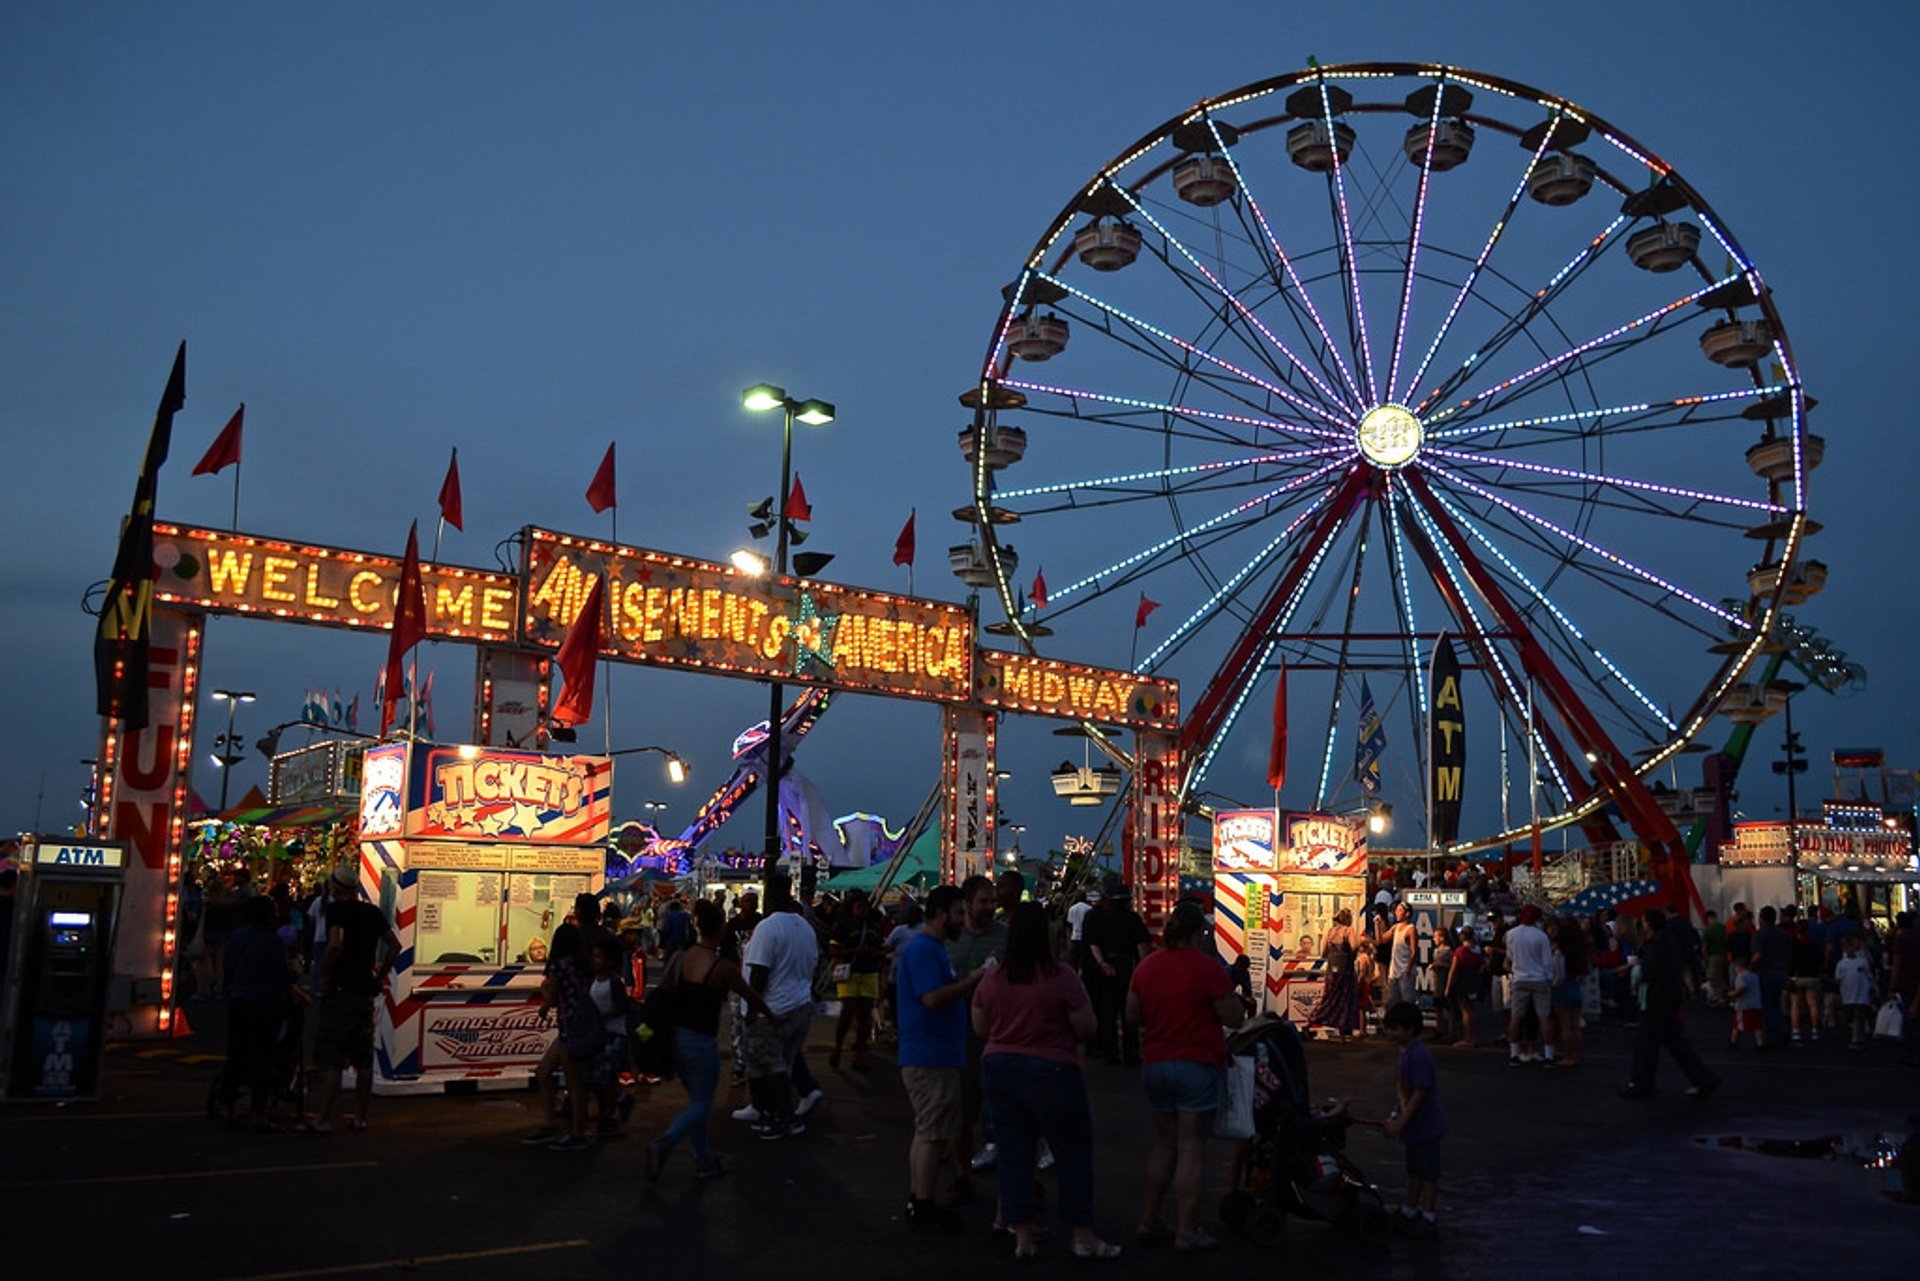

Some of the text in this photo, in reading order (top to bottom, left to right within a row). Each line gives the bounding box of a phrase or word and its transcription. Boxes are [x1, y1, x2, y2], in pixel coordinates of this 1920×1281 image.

[207, 547, 513, 630] WELCME
[832, 613, 963, 680] AMERICA
[1003, 664, 1134, 713] MIDWAY
[1437, 676, 1462, 801] ATM
[437, 759, 584, 818] TICKETS
[56, 848, 105, 865] ATM
[1290, 820, 1355, 855] TICKETS
[1864, 839, 1911, 856] PHOTOS
[1415, 911, 1435, 991] ATM
[43, 1019, 74, 1071] ATM
